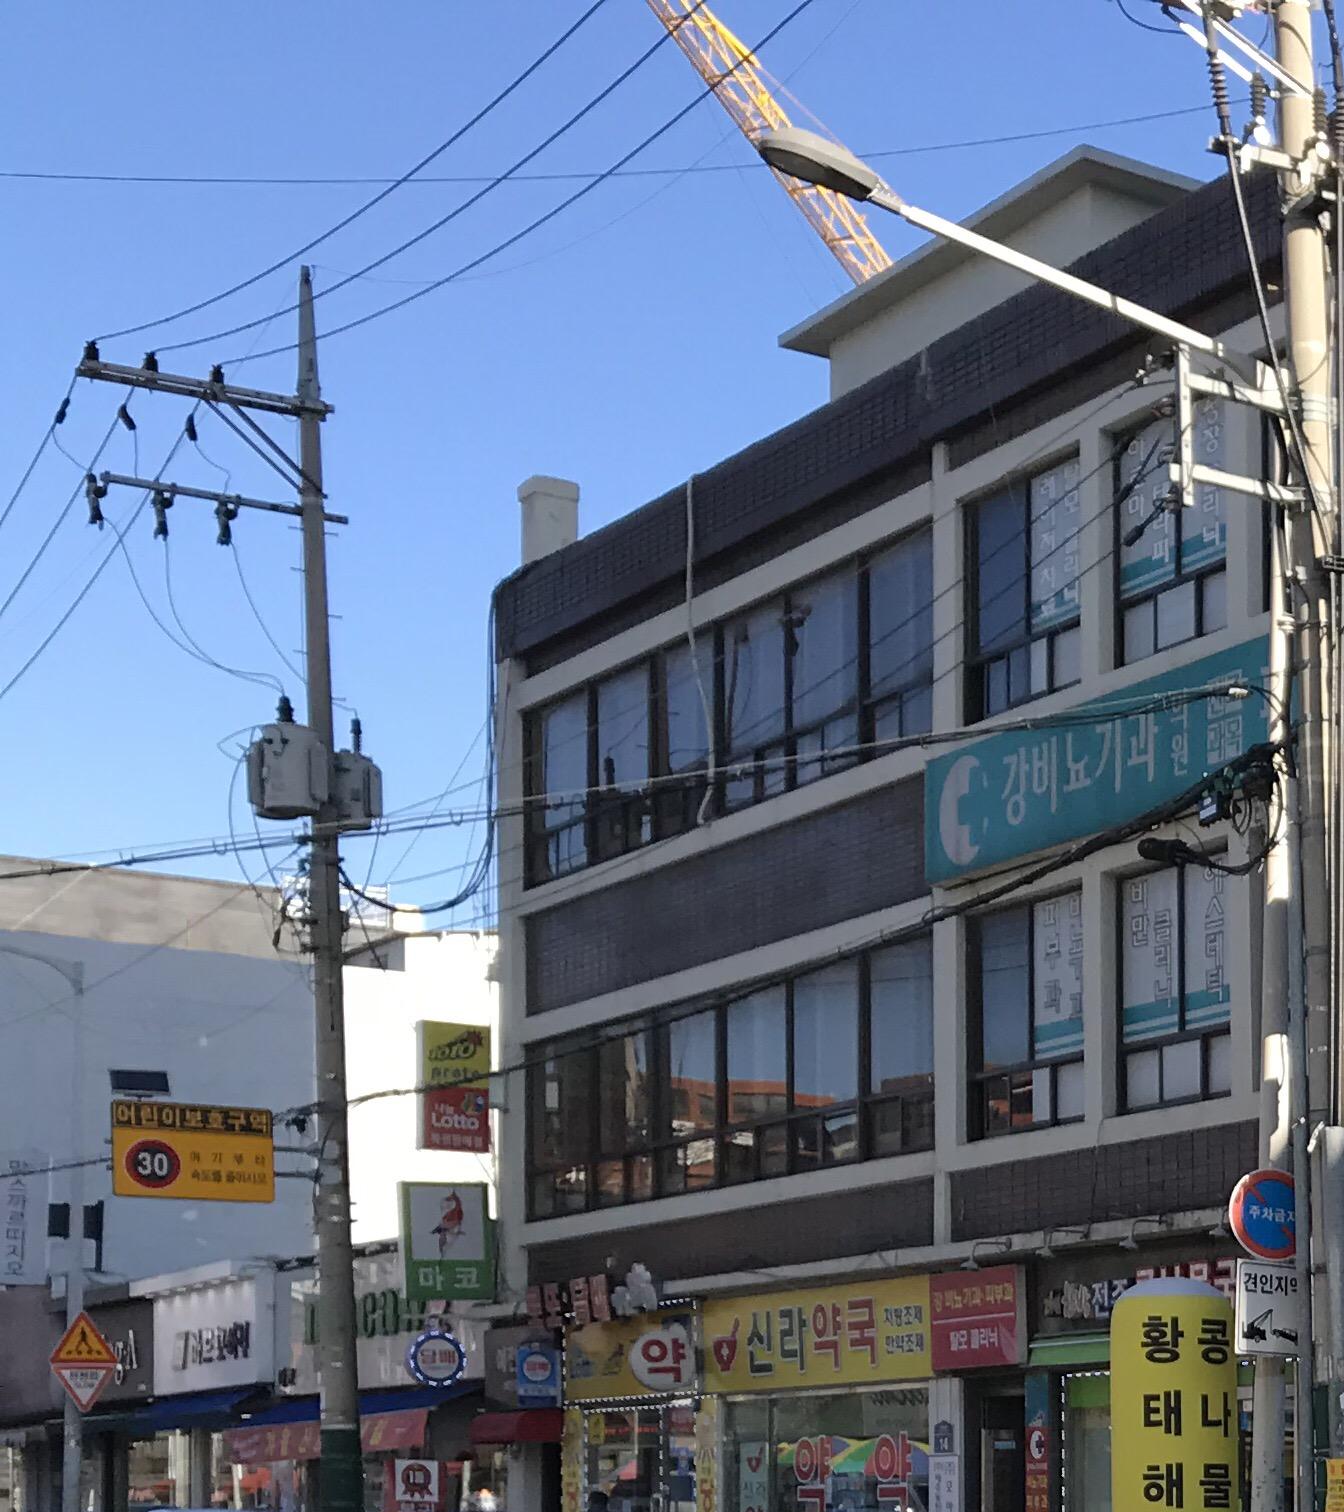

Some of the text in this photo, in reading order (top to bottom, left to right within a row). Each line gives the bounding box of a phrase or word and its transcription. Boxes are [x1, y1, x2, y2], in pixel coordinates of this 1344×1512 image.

[1001, 712, 1159, 826] 강비뇨기과
[1130, 880, 1149, 948] 비만
[115, 1104, 269, 1136] 어린이보호구역
[431, 1111, 480, 1129] Lotto
[137, 1152, 168, 1177] 30
[418, 1266, 481, 1291] 마코
[747, 1296, 878, 1376] 신라약국
[641, 1338, 687, 1384] 약
